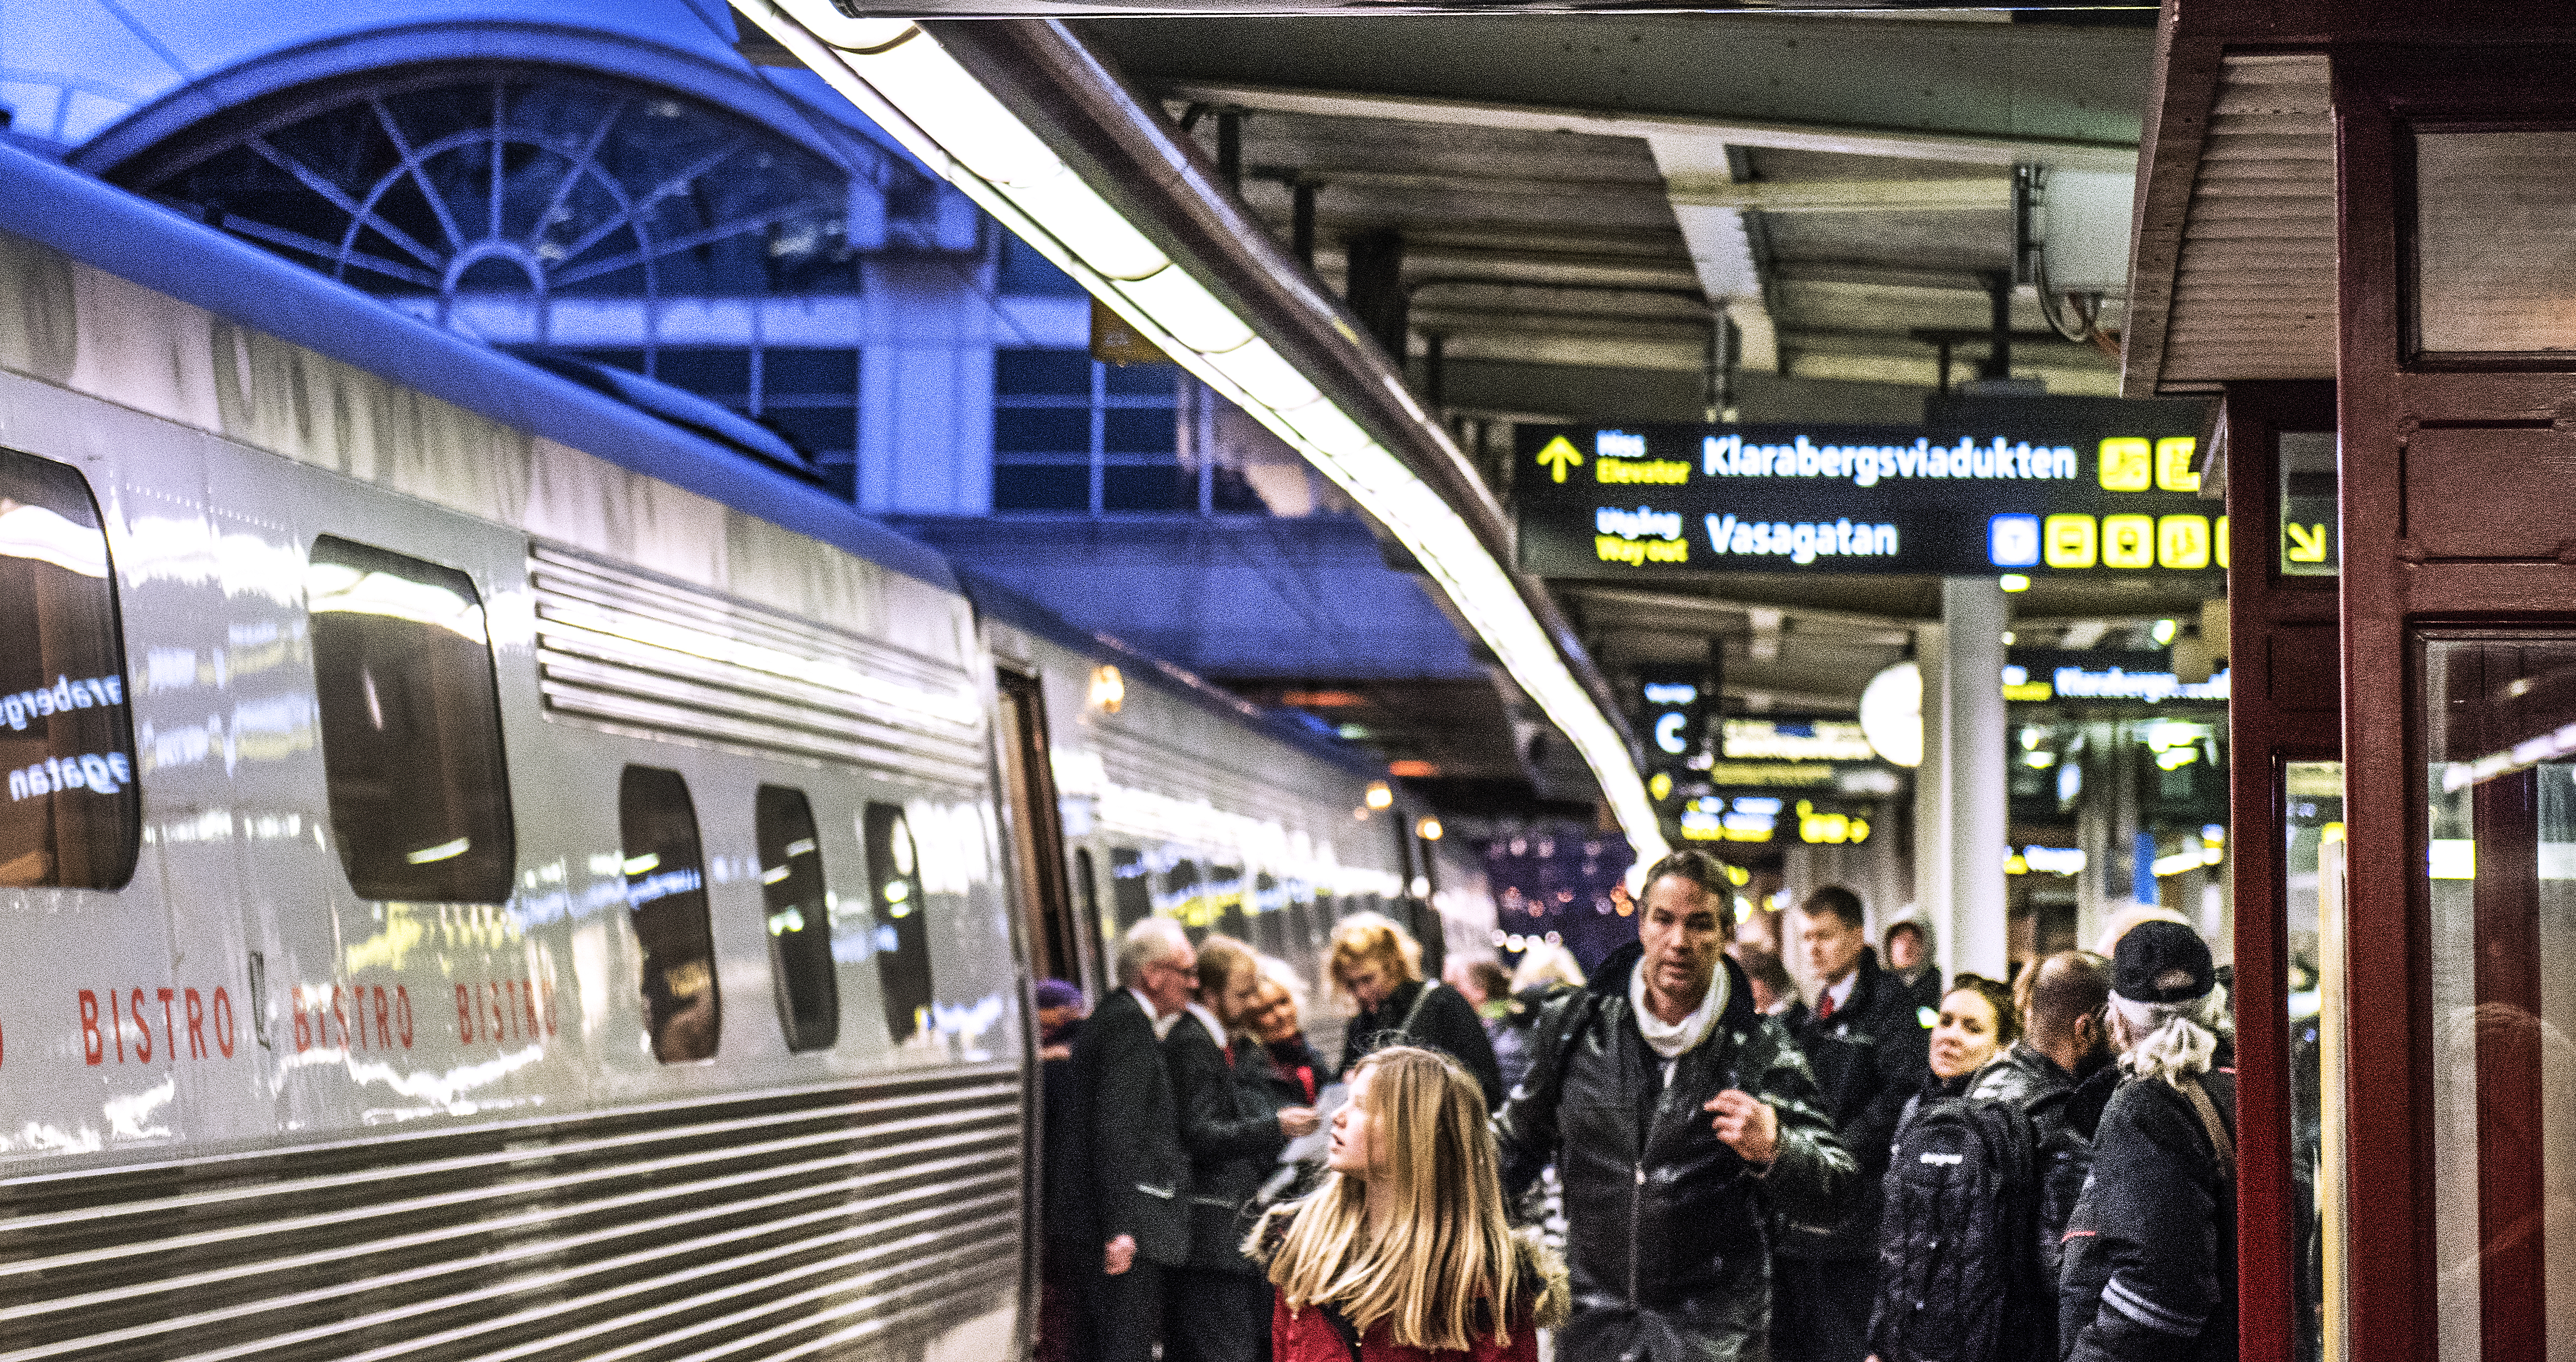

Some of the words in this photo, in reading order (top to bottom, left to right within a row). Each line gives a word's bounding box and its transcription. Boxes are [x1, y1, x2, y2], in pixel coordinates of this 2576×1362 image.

[1702, 434, 2077, 487] Klarabergsviadukten
[1704, 513, 1898, 564] Vasagatan
[78, 986, 234, 1066] BISTRO
[291, 985, 413, 1053] BISTRO
[455, 978, 556, 1045] BISTRO
